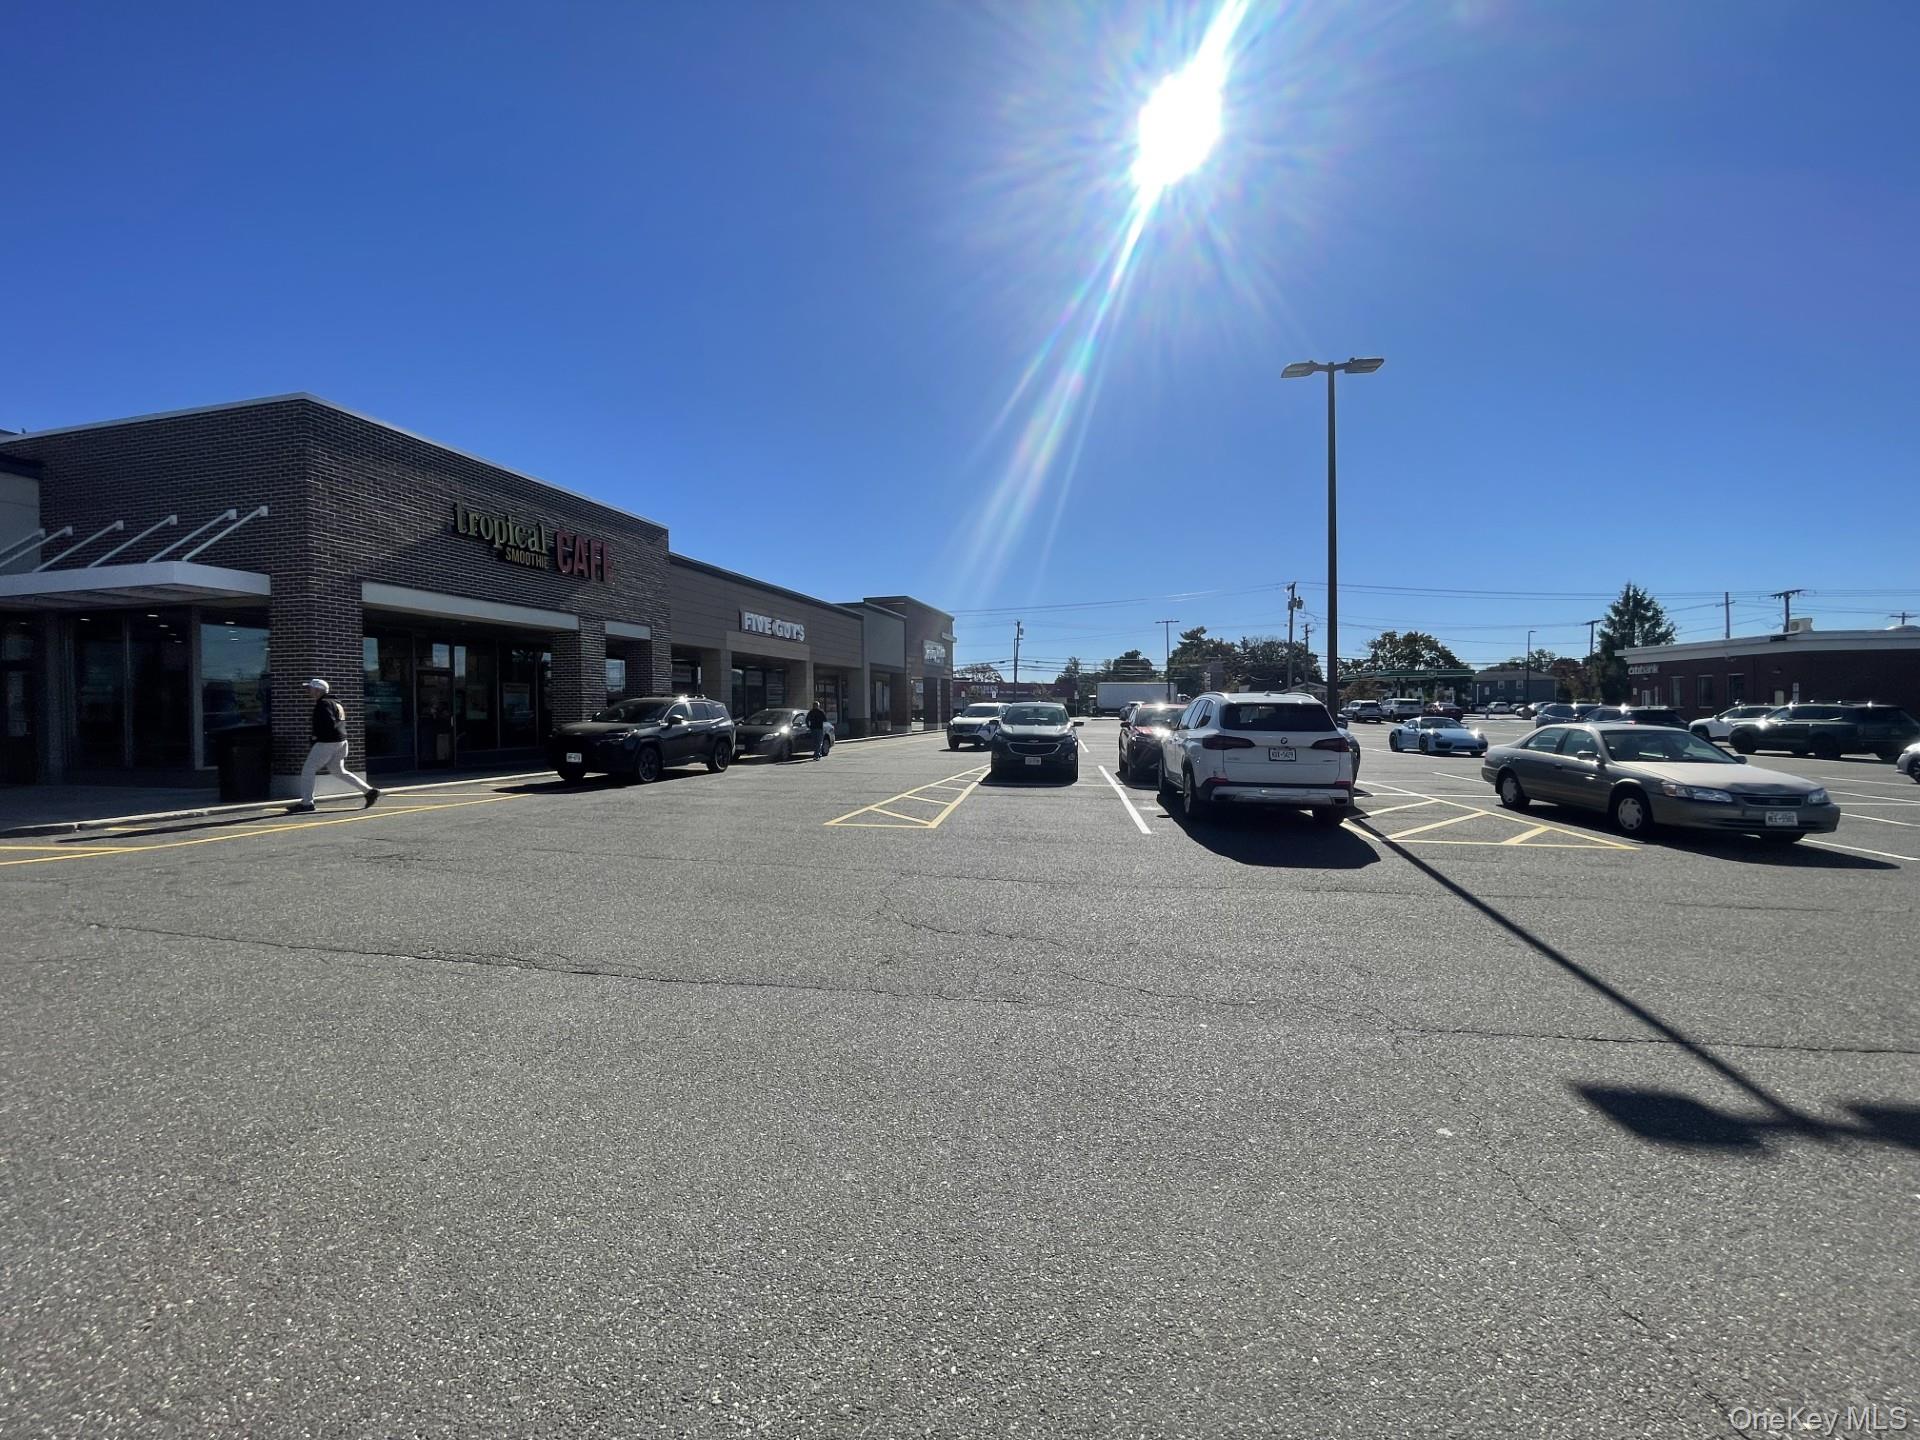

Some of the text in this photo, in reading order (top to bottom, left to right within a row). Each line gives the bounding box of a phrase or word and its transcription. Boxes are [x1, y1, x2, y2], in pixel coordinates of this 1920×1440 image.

[455, 501, 549, 554] tropical
[505, 547, 549, 569] SMOOTHIE
[744, 612, 805, 642] FIVE GUYS
